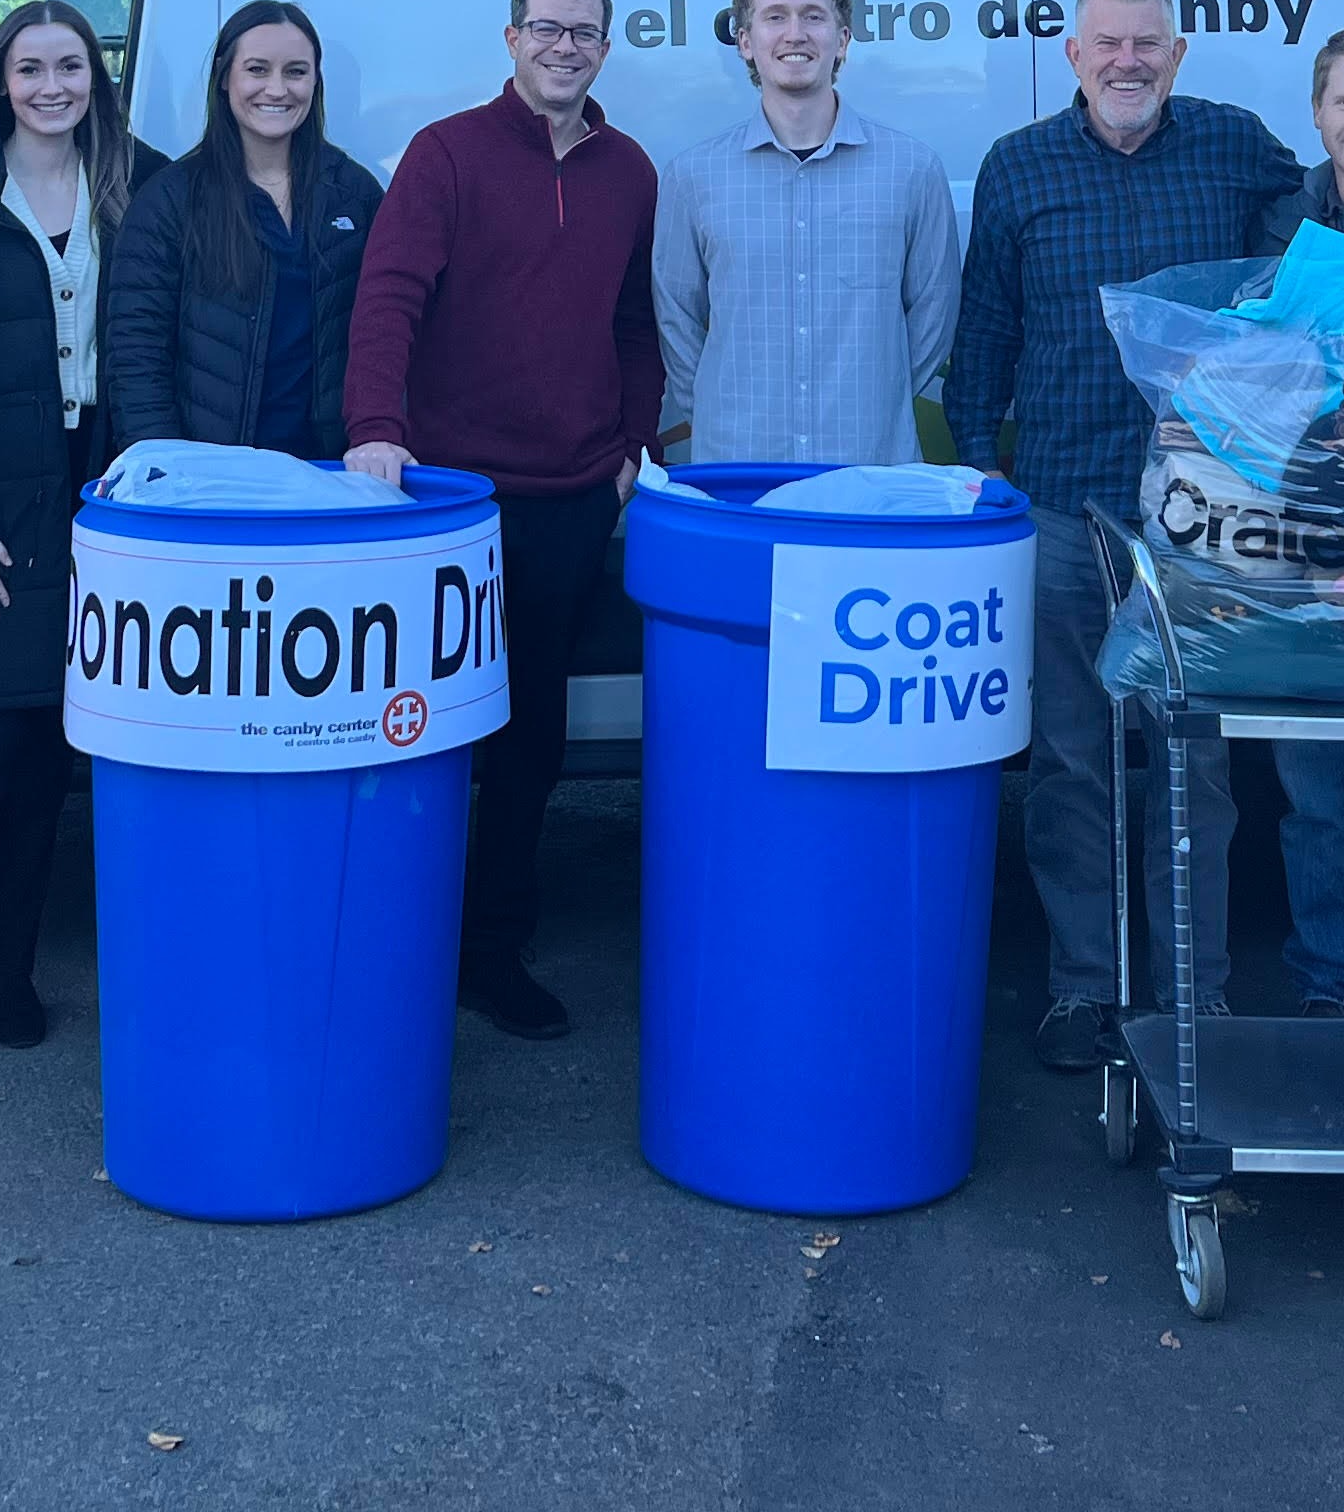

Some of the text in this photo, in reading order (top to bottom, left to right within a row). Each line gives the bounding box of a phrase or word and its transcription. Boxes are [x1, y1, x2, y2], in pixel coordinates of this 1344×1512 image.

[834, 587, 1004, 651] Coat
[819, 655, 1009, 725] Drive
[240, 718, 378, 738] the canby center
[284, 738, 294, 747] el
[333, 733, 346, 745] de
[347, 733, 377, 744] canby
